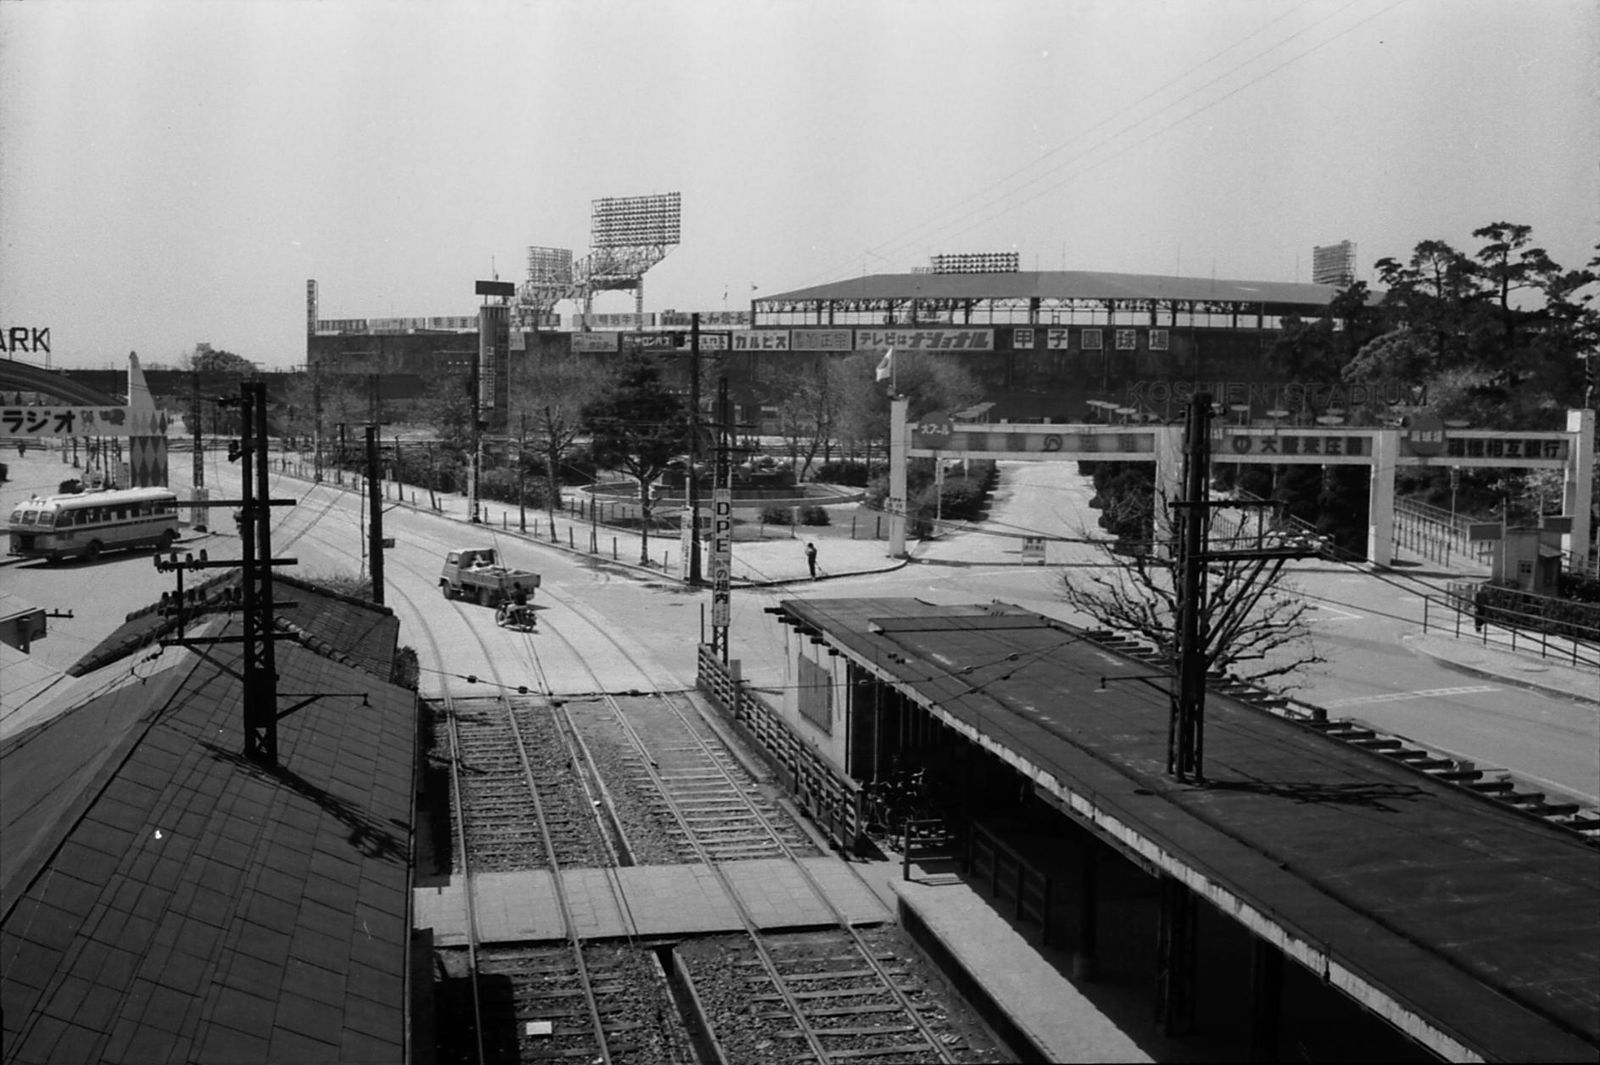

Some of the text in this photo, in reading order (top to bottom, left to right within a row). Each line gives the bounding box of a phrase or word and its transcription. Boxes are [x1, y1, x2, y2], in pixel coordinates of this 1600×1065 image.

[1284, 383, 1428, 407] STADIUM
[2, 410, 76, 433] ラジオ
